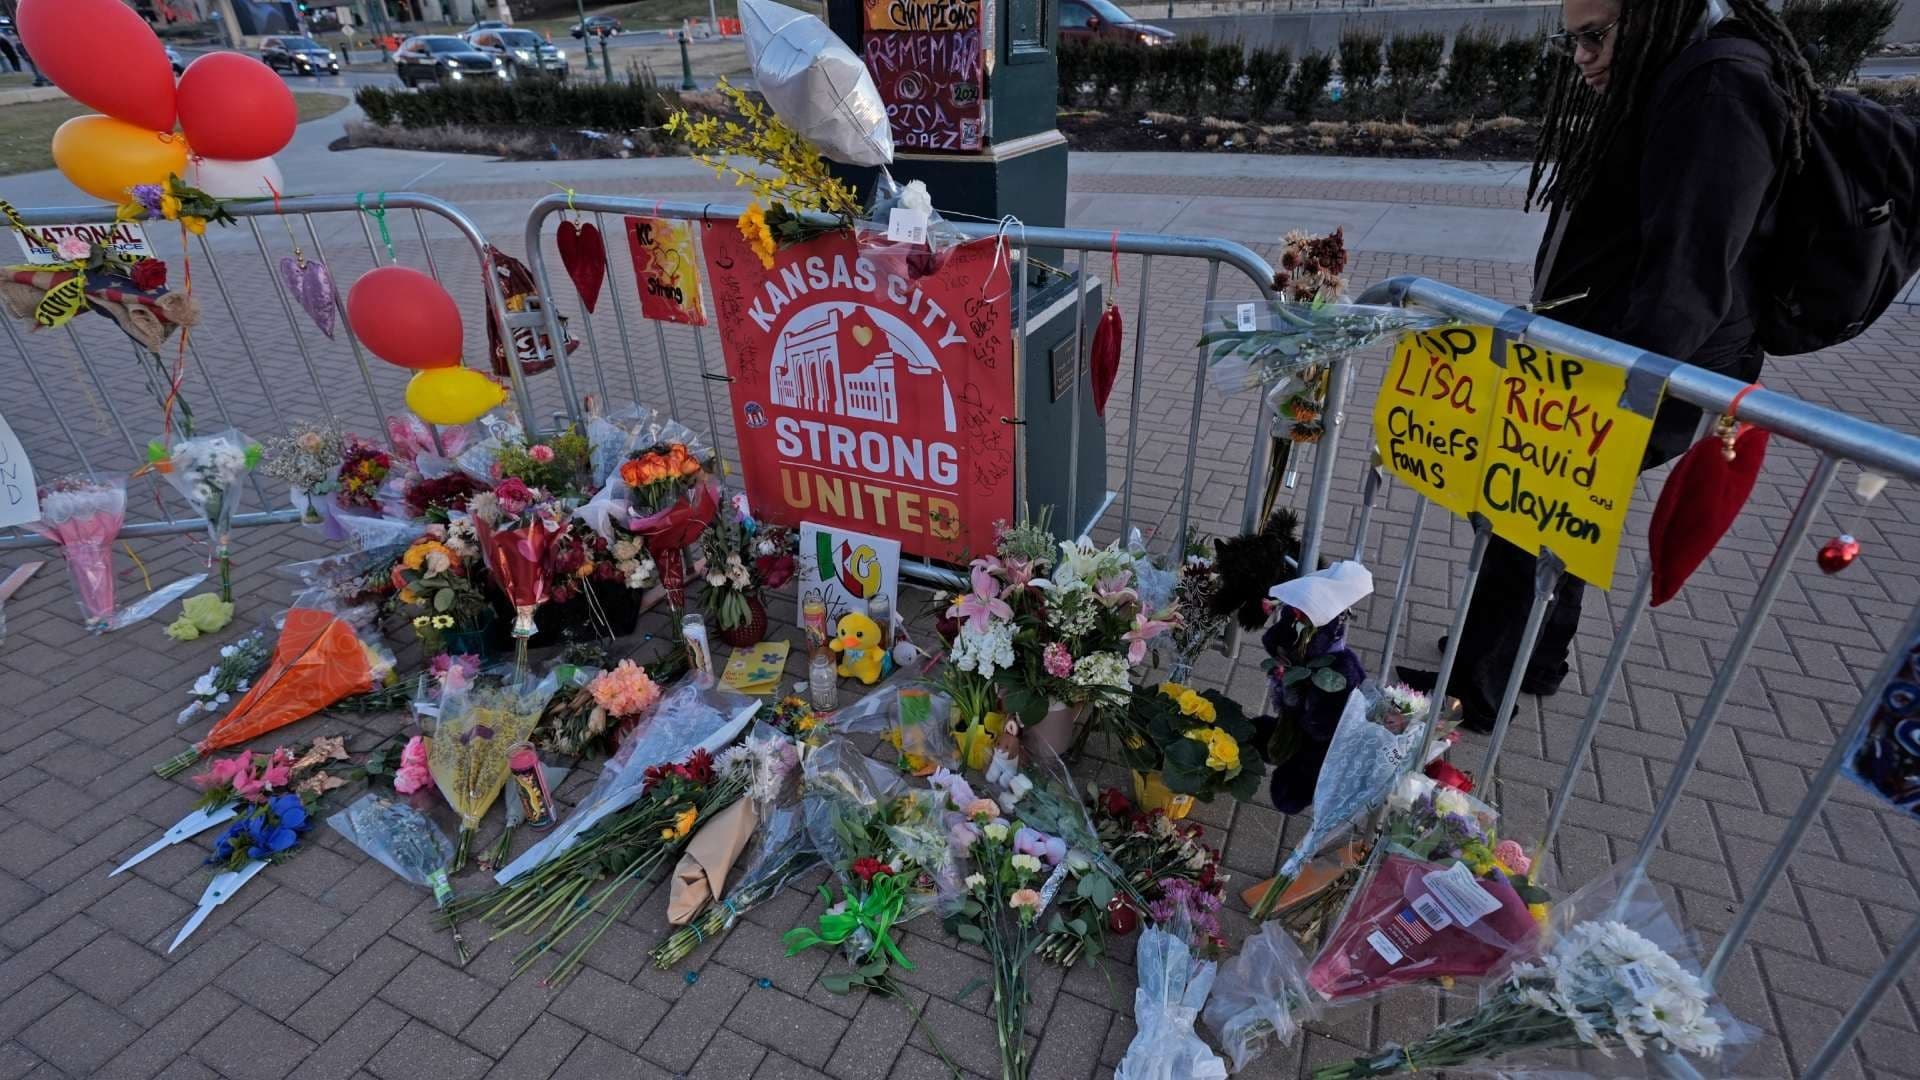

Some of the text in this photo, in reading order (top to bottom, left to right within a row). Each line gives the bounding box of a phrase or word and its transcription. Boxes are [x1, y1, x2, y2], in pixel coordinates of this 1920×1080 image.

[636, 223, 654, 246] KC
[647, 276, 683, 305] Strong
[747, 254, 876, 333] KANSAS
[887, 273, 967, 349] CITY
[1395, 349, 1476, 415] Lisa
[1503, 376, 1614, 456] Ricky
[774, 416, 958, 486] STRONG
[1389, 438, 1446, 490] Fans
[1496, 416, 1596, 488] David
[780, 468, 961, 540] UNITED
[1483, 462, 1601, 545] Clayton
[1588, 494, 1613, 511] and
